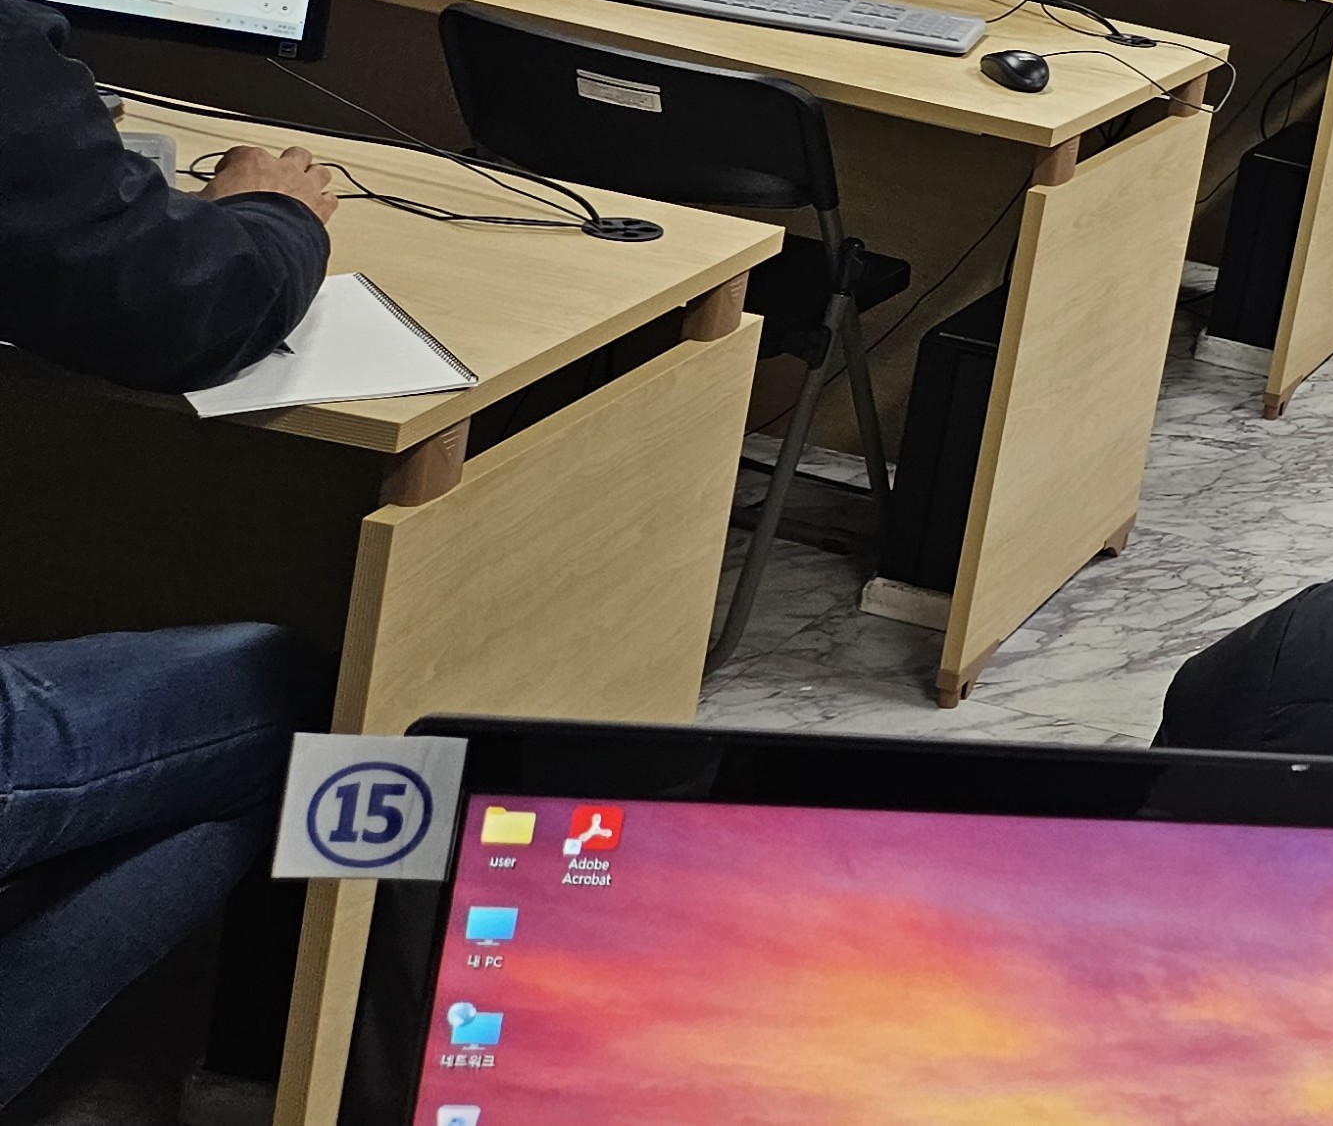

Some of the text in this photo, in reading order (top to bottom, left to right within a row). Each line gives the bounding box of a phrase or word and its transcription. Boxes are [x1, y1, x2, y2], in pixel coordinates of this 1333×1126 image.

[328, 781, 408, 845] 15
[489, 857, 517, 868] user
[568, 857, 610, 870] Adobe
[562, 872, 612, 886] Acrobat
[467, 954, 504, 969] 내 PC
[440, 1054, 495, 1068] 네트워크
